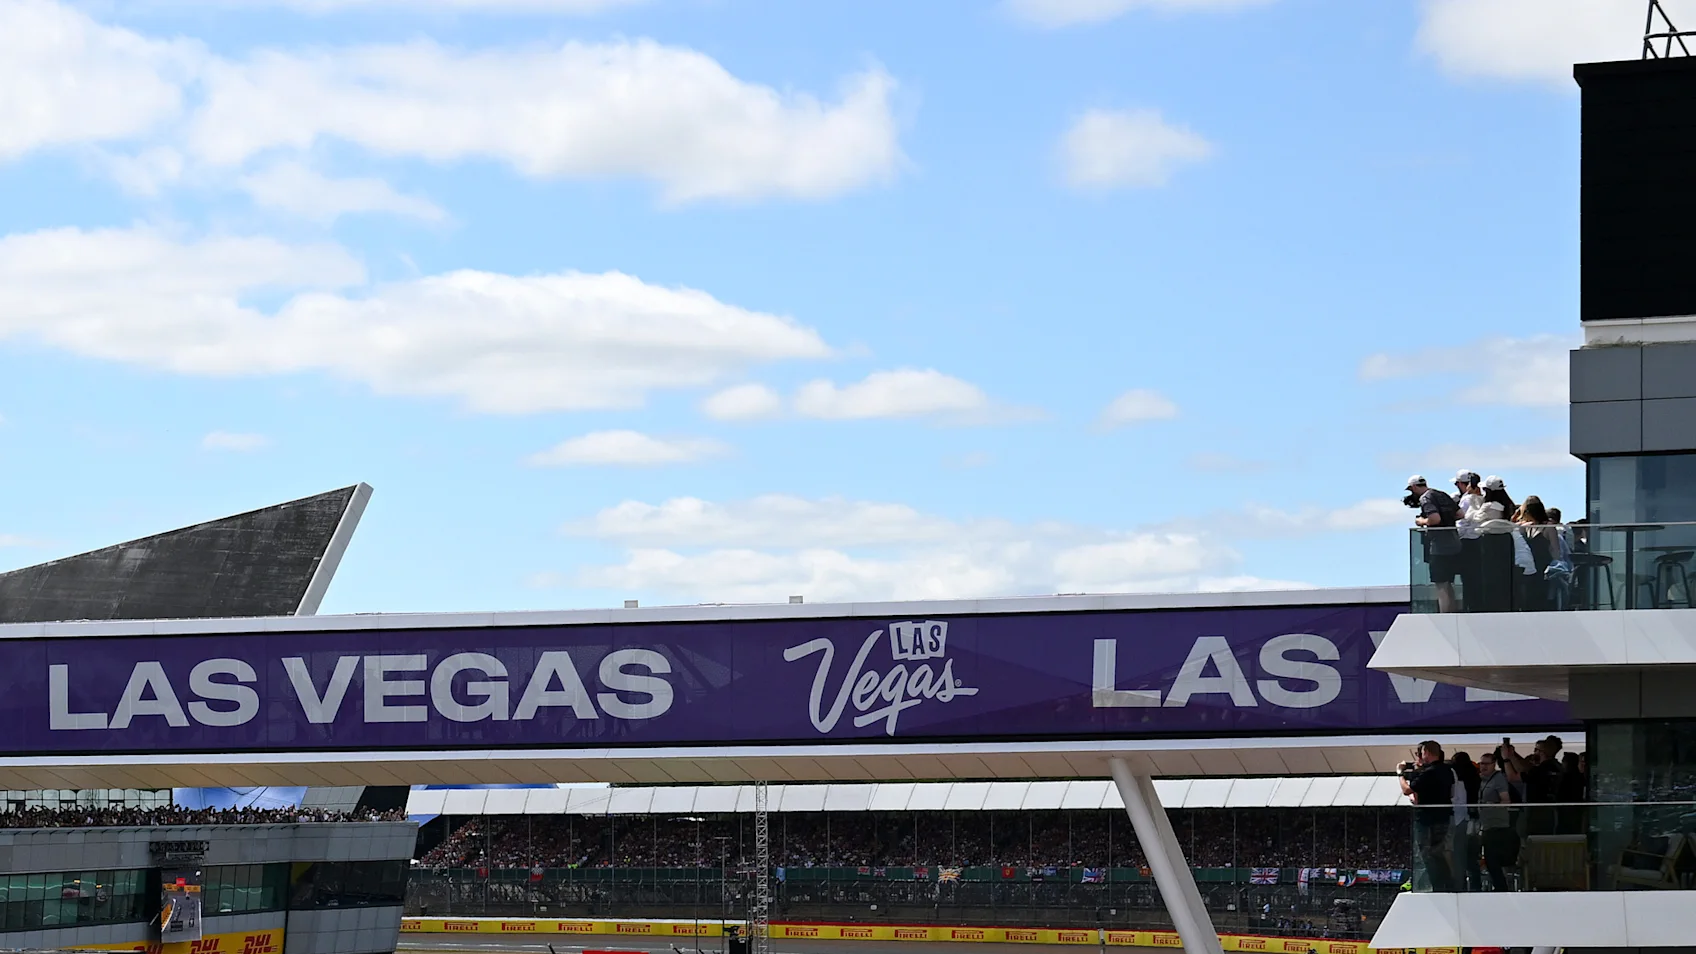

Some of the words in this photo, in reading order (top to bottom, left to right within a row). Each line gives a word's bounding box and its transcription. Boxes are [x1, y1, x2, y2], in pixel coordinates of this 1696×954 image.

[893, 623, 944, 658] LAS
[1092, 633, 1342, 708] LAS
[48, 658, 260, 730] LAS
[282, 649, 674, 724] VEGAS
[783, 637, 979, 736] Vegas
[444, 921, 478, 931] PIRELLI
[502, 921, 535, 931] PIRELLI
[558, 922, 593, 932] PIRELLI
[616, 923, 650, 933] PIRELLI
[785, 927, 818, 936] PIRELLI
[840, 928, 872, 938] PIRELLI
[894, 929, 927, 938] PIRELLI
[951, 930, 984, 940] PIRELLI
[1005, 931, 1037, 940] PIRELLI
[1058, 932, 1088, 942] PIRELLI
[243, 934, 272, 954] DHL
